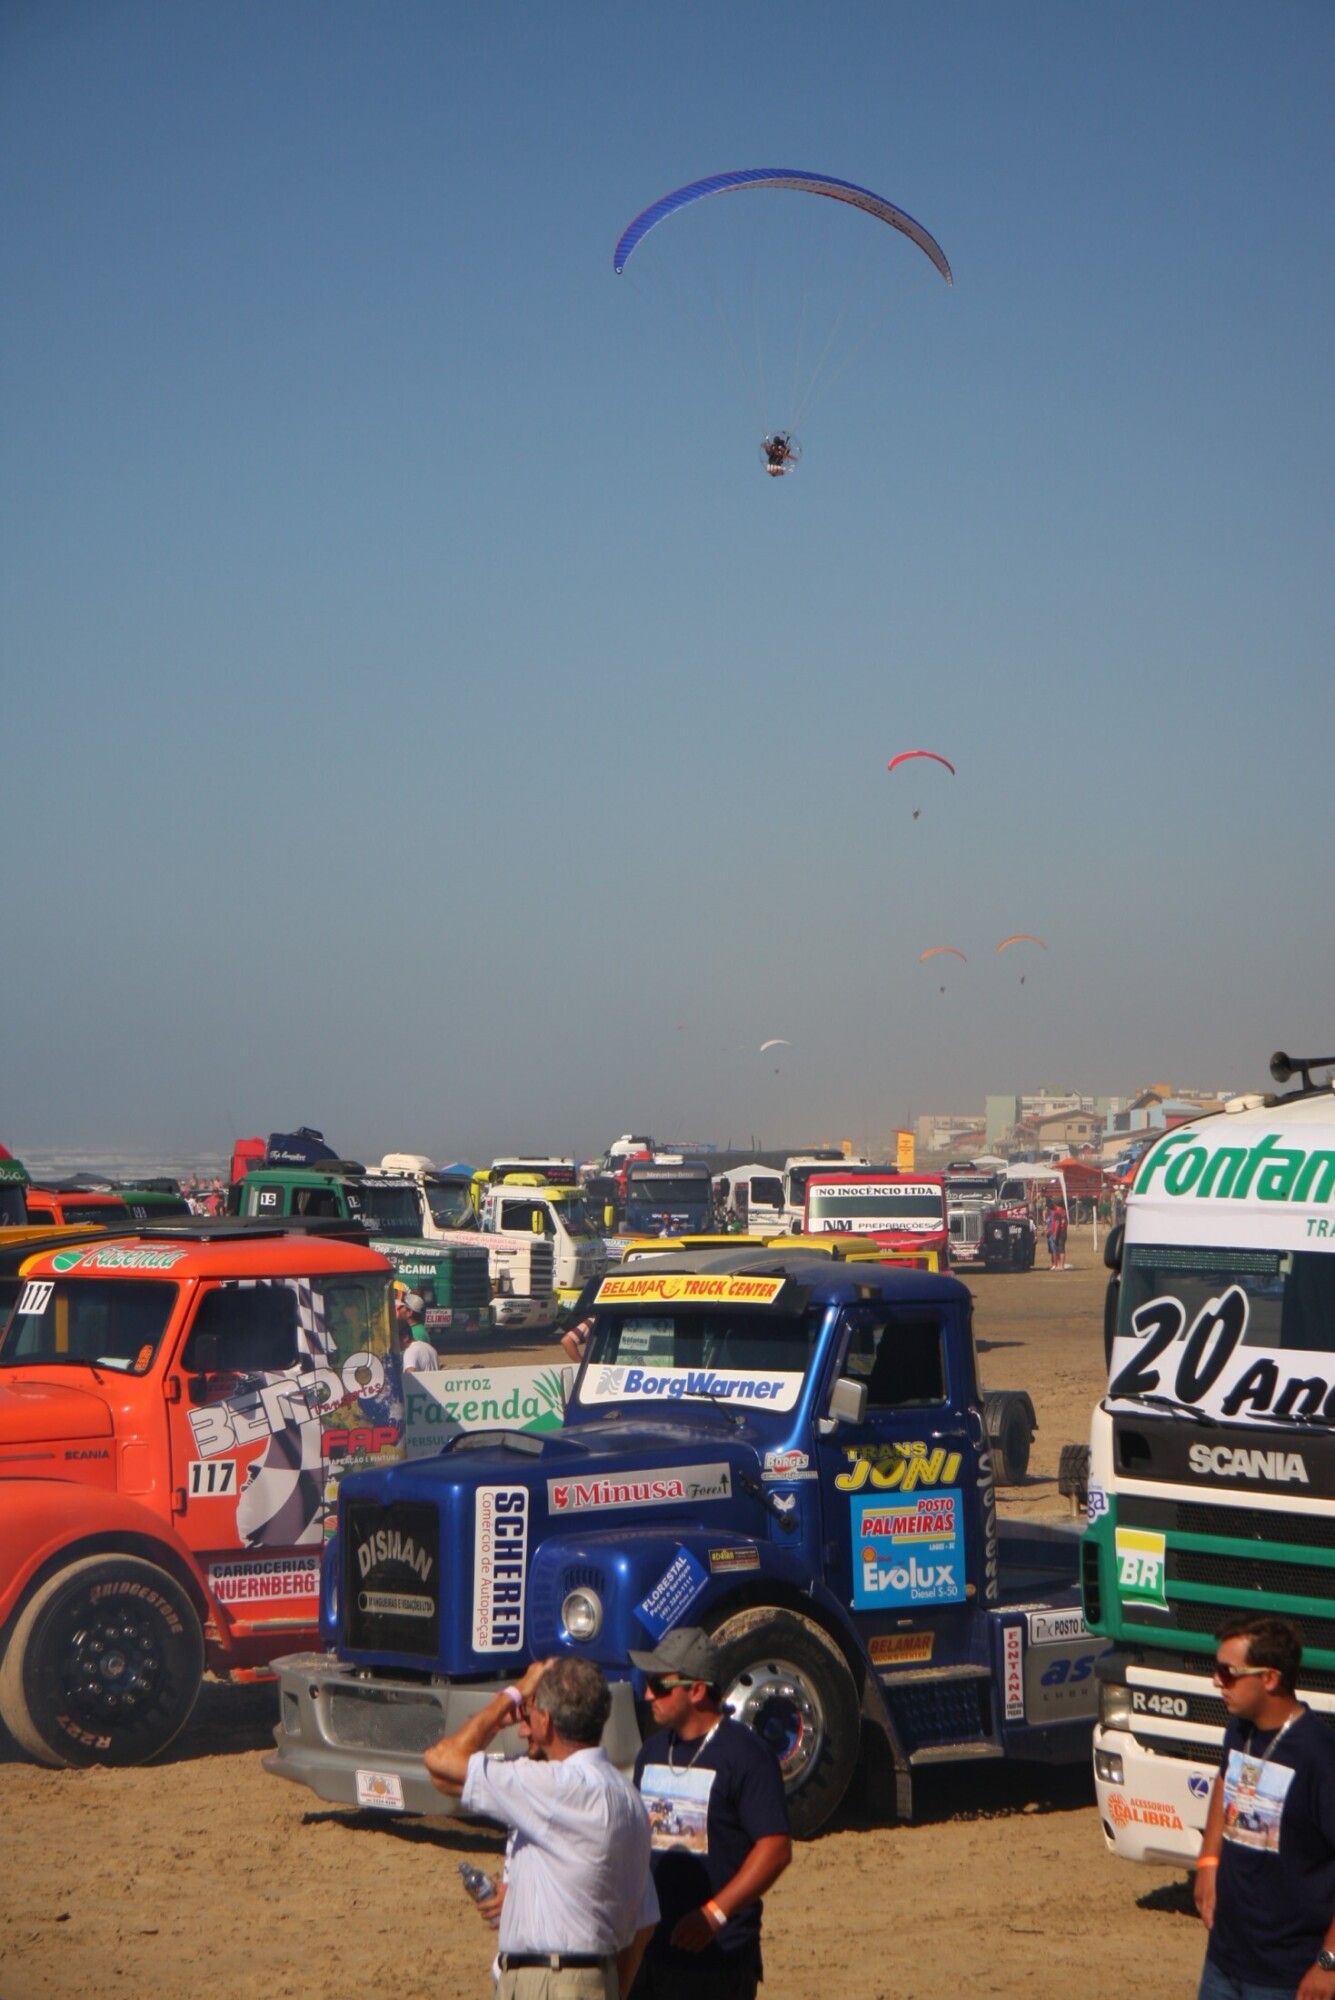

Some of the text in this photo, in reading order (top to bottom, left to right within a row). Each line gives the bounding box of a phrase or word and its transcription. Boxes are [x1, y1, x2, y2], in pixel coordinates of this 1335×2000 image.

[1135, 1133, 1335, 1203] Fontan
[261, 1193, 275, 1205] 15
[838, 1186, 901, 1195] INOCÊNCIO
[904, 1187, 937, 1195] LTDA.
[823, 1220, 853, 1231] NM
[399, 1265, 437, 1275] SCANIA
[21, 1284, 53, 1310] 117
[601, 1280, 777, 1298] BELAMAR TRUCK CENTER
[1110, 1285, 1249, 1403] 20
[444, 1378, 491, 1392] arroz
[624, 1370, 785, 1399] BorgWarner
[406, 1388, 541, 1425] Fazenda
[64, 1450, 110, 1460] SCANIA
[322, 1427, 398, 1457] FAP
[842, 1441, 927, 1461] TRANS
[766, 1453, 808, 1468] BORGES
[835, 1448, 962, 1492] JONI
[1189, 1443, 1309, 1483] SCANIA
[192, 1463, 235, 1493] 117
[574, 1479, 684, 1507] Minusa
[917, 1498, 954, 1512] POSTO
[861, 1513, 954, 1537] PALMEIRAS
[213, 1559, 316, 1578] CARROCERIAS
[358, 1530, 433, 1583] DISMAN
[476, 1492, 494, 1647] Comércio de Autopeças
[491, 1492, 526, 1646] SCHERER
[642, 1557, 687, 1612] FLORESTAL
[863, 1557, 955, 1591] Evolux
[1119, 1557, 1159, 1589] BR
[213, 1574, 315, 1600] NUERNBERG
[911, 1586, 958, 1599] Diesel S-50
[90, 1581, 183, 1634] BRIDGESTONE
[1054, 1619, 1079, 1635] POSTO
[871, 1634, 931, 1654] BELAMAR
[1007, 1631, 1020, 1702] FONTANA
[1040, 1650, 1113, 1687] as
[56, 1715, 112, 1748] R227
[1114, 1803, 1183, 1830] CALIBRA
[1130, 1798, 1176, 1813] ACESSORIOS
